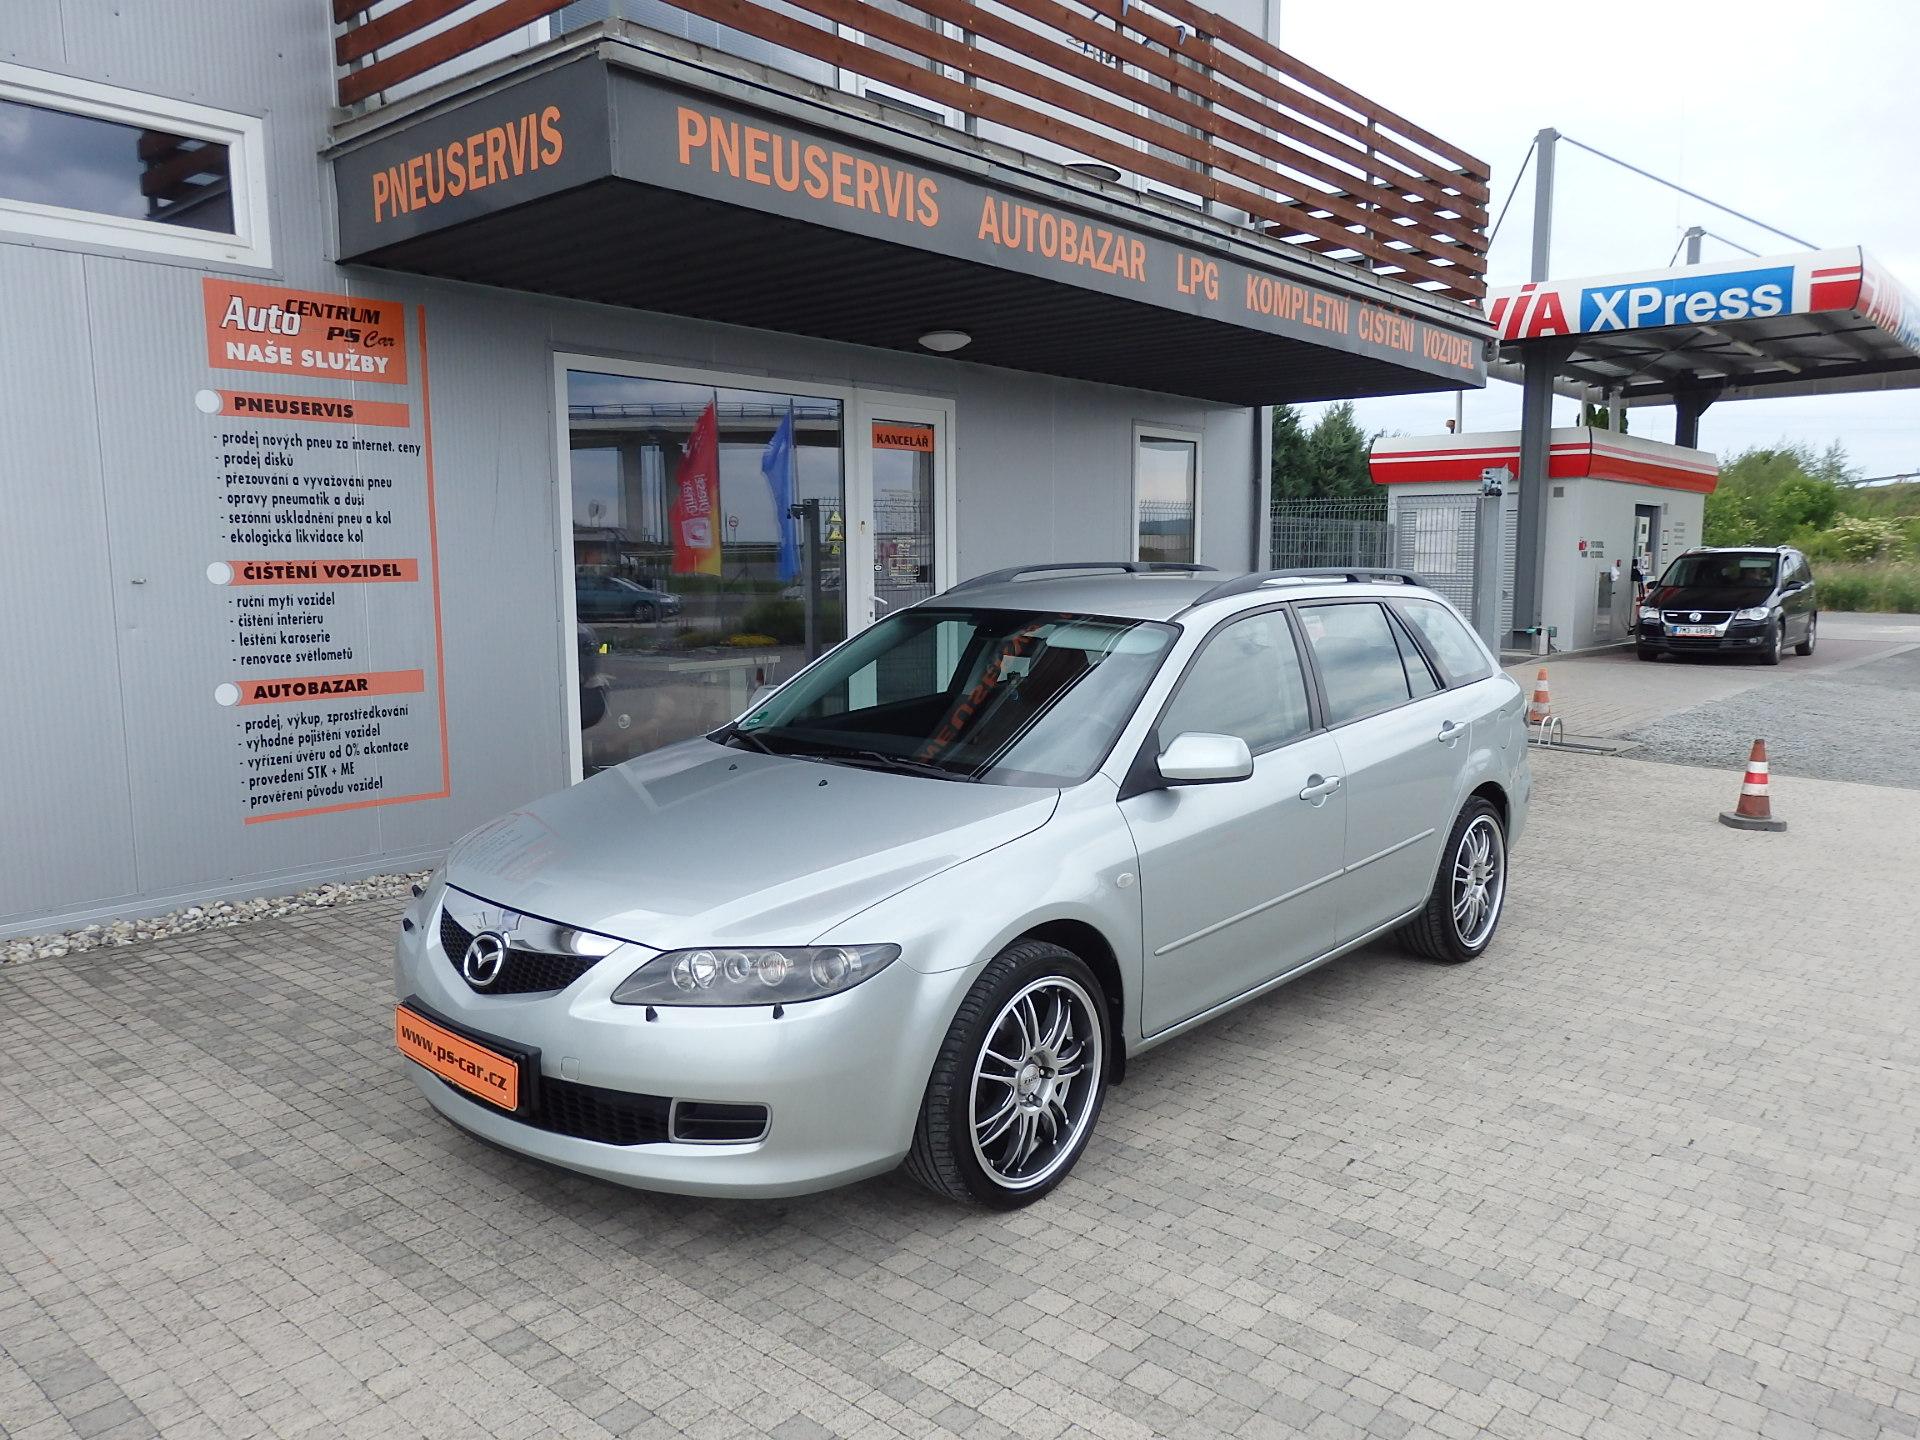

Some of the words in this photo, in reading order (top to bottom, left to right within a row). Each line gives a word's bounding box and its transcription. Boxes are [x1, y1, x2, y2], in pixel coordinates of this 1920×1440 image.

[372, 106, 564, 223] PNEUSERVIS
[676, 106, 940, 228] PNEUSERVIS
[978, 196, 1146, 282] AUTOBAZAR
[1177, 254, 1219, 301] LPG
[1246, 274, 1349, 335] KOMPLETNÍ
[1423, 327, 1475, 370] VOZIDEL
[219, 295, 302, 336] Auto
[285, 299, 380, 325] CENTRUM
[1588, 283, 1783, 333] XPress
[327, 326, 361, 343] PS
[363, 330, 396, 348] Car
[226, 339, 293, 366] NAŠE
[301, 348, 389, 374] SLUŽBY
[234, 397, 354, 418] PNEUSERVIS
[222, 431, 259, 448] prodej
[263, 433, 302, 450] nových
[306, 438, 332, 450] pneu
[336, 440, 348, 450] za
[352, 436, 395, 452] internet.
[398, 443, 421, 456] ceny
[876, 433, 928, 447] KANCELÁŘ
[224, 451, 260, 469] prodej
[264, 452, 294, 466] disků
[226, 472, 288, 488] přezouvání
[293, 477, 299, 486] a
[303, 475, 364, 490] vyvažování
[368, 478, 392, 490] pneu
[227, 494, 267, 508] opravy
[272, 491, 330, 508] pneumatik
[334, 496, 340, 505] a
[229, 511, 271, 523] sezónní
[275, 510, 334, 524] uskladnění
[337, 515, 362, 527] pneu
[366, 515, 372, 524] a
[376, 511, 391, 524] kol
[231, 529, 292, 546] ekologická
[296, 529, 344, 542] likvidace
[348, 529, 364, 542] kol
[243, 561, 318, 580] ČIŠTĚNÍ
[323, 563, 402, 579] VOZIDEL
[237, 595, 264, 607] ruční
[297, 592, 335, 606] vozidel
[238, 613, 274, 627] čištění
[277, 611, 323, 625] interiéru
[240, 632, 276, 646] leštění
[280, 629, 330, 644] karoserie
[241, 653, 292, 665] renovace
[296, 647, 353, 662] světlometů
[253, 678, 368, 700] AUTOBAZAR
[245, 714, 283, 734] prodej,
[287, 712, 323, 729] výkup,
[327, 704, 409, 725] zprostředkování
[246, 732, 294, 752] výhodné
[298, 728, 341, 747] pojištění
[345, 723, 380, 739] vozidel
[248, 752, 293, 771] vyřízení
[296, 750, 326, 763] úvěru
[329, 745, 341, 758] od
[345, 743, 360, 757] 0%
[363, 741, 409, 755] akontace
[249, 769, 304, 790] provedení
[307, 765, 328, 779] STK
[332, 767, 337, 775] +
[341, 762, 355, 776] ME
[250, 787, 303, 809] prověření
[306, 781, 344, 801] původu
[348, 776, 383, 792] vozidel
[401, 1025, 507, 1091] www.ps-car.cz
